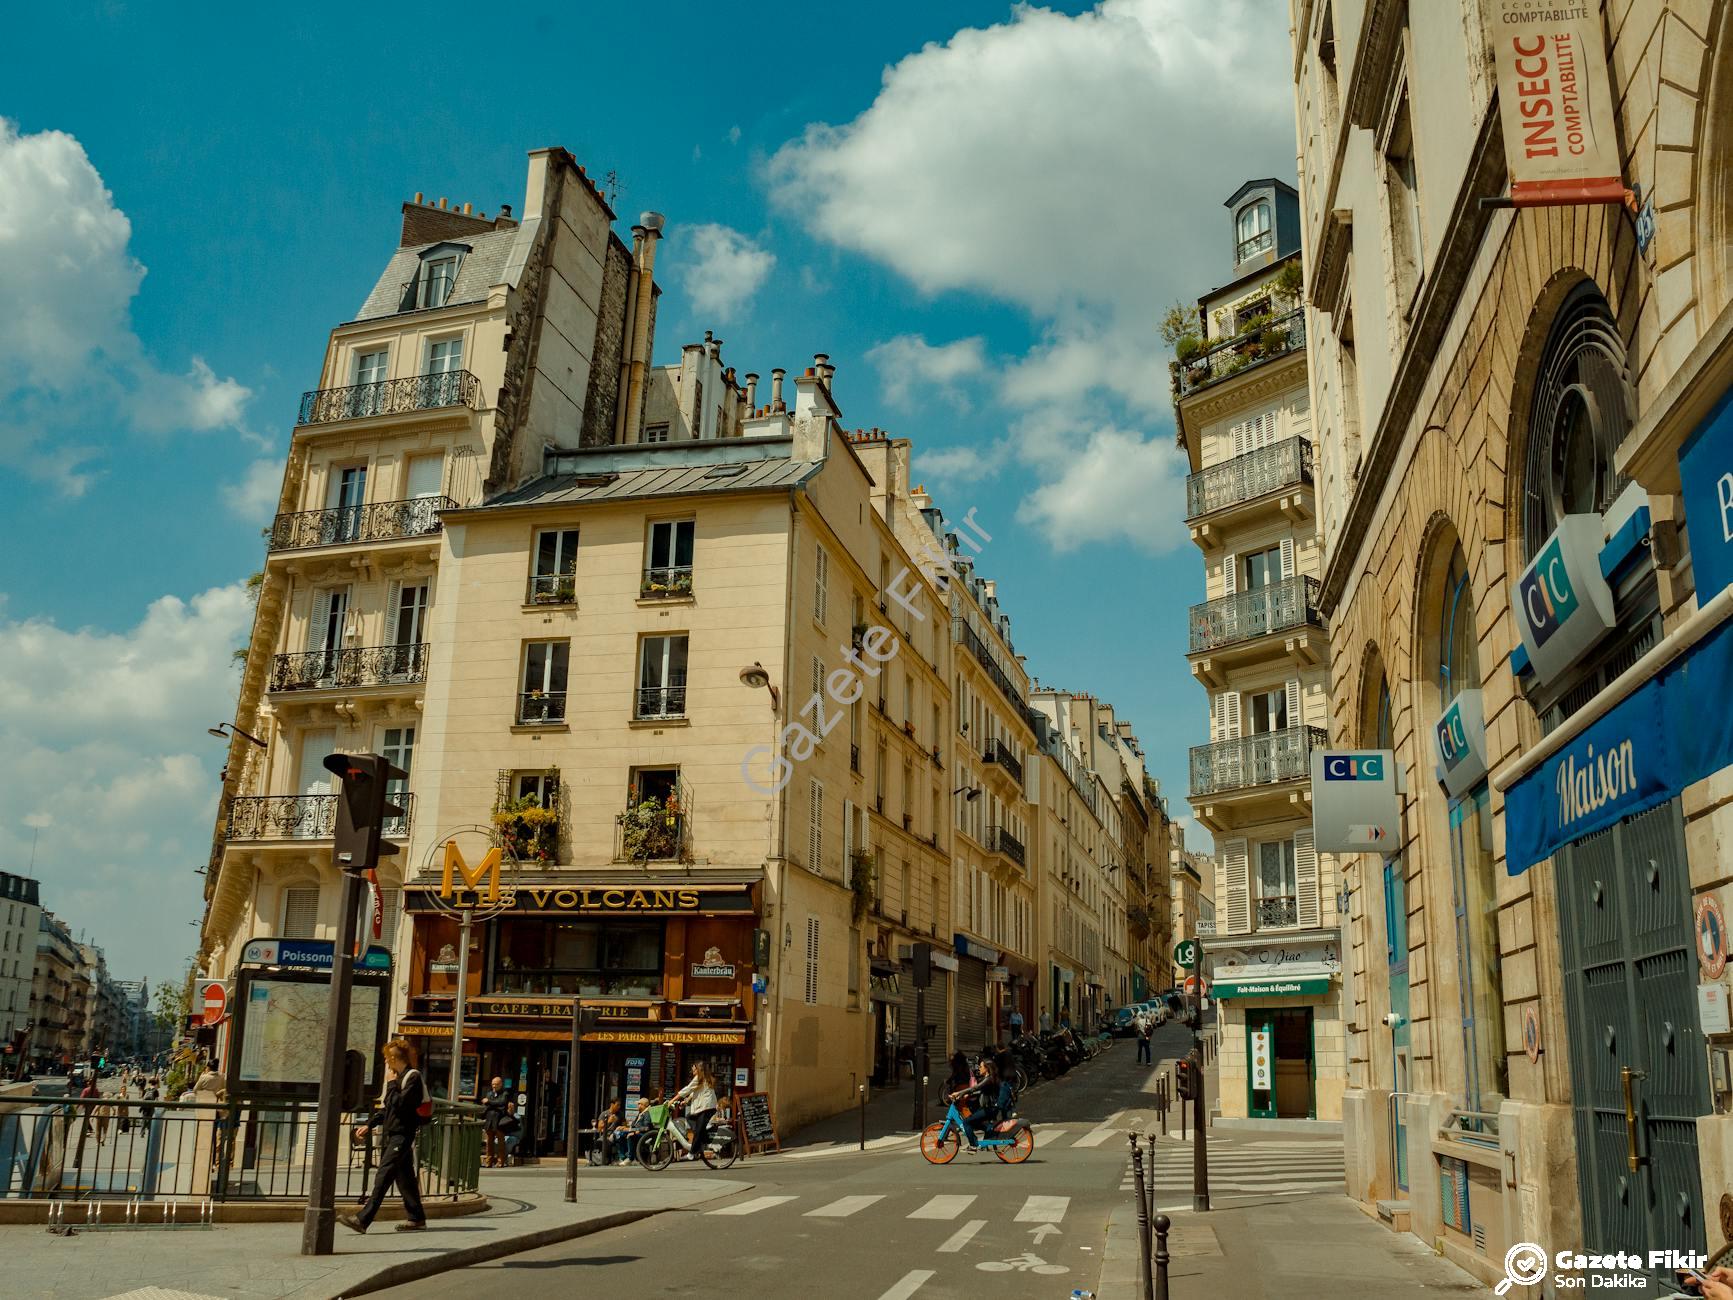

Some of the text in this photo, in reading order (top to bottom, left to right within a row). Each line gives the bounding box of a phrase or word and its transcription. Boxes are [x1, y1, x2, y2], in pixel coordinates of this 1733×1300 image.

[1512, 34, 1559, 160] INSECC
[1550, 32, 1585, 156] COMPTABILITÉ
[1527, 556, 1569, 629] CIC
[1441, 714, 1465, 760] CIC
[1329, 759, 1378, 776] CIC
[1556, 739, 1637, 829] Maison
[440, 840, 503, 901] M
[373, 883, 382, 925] TABAC
[454, 889, 700, 909] LES VOLCANS
[282, 950, 333, 963] Poissonn
[404, 1026, 456, 1035] LES VOLCAN
[543, 1005, 629, 1016] BRARIE
[598, 1032, 738, 1042] LES PARIS MUTUELS URBAINS
